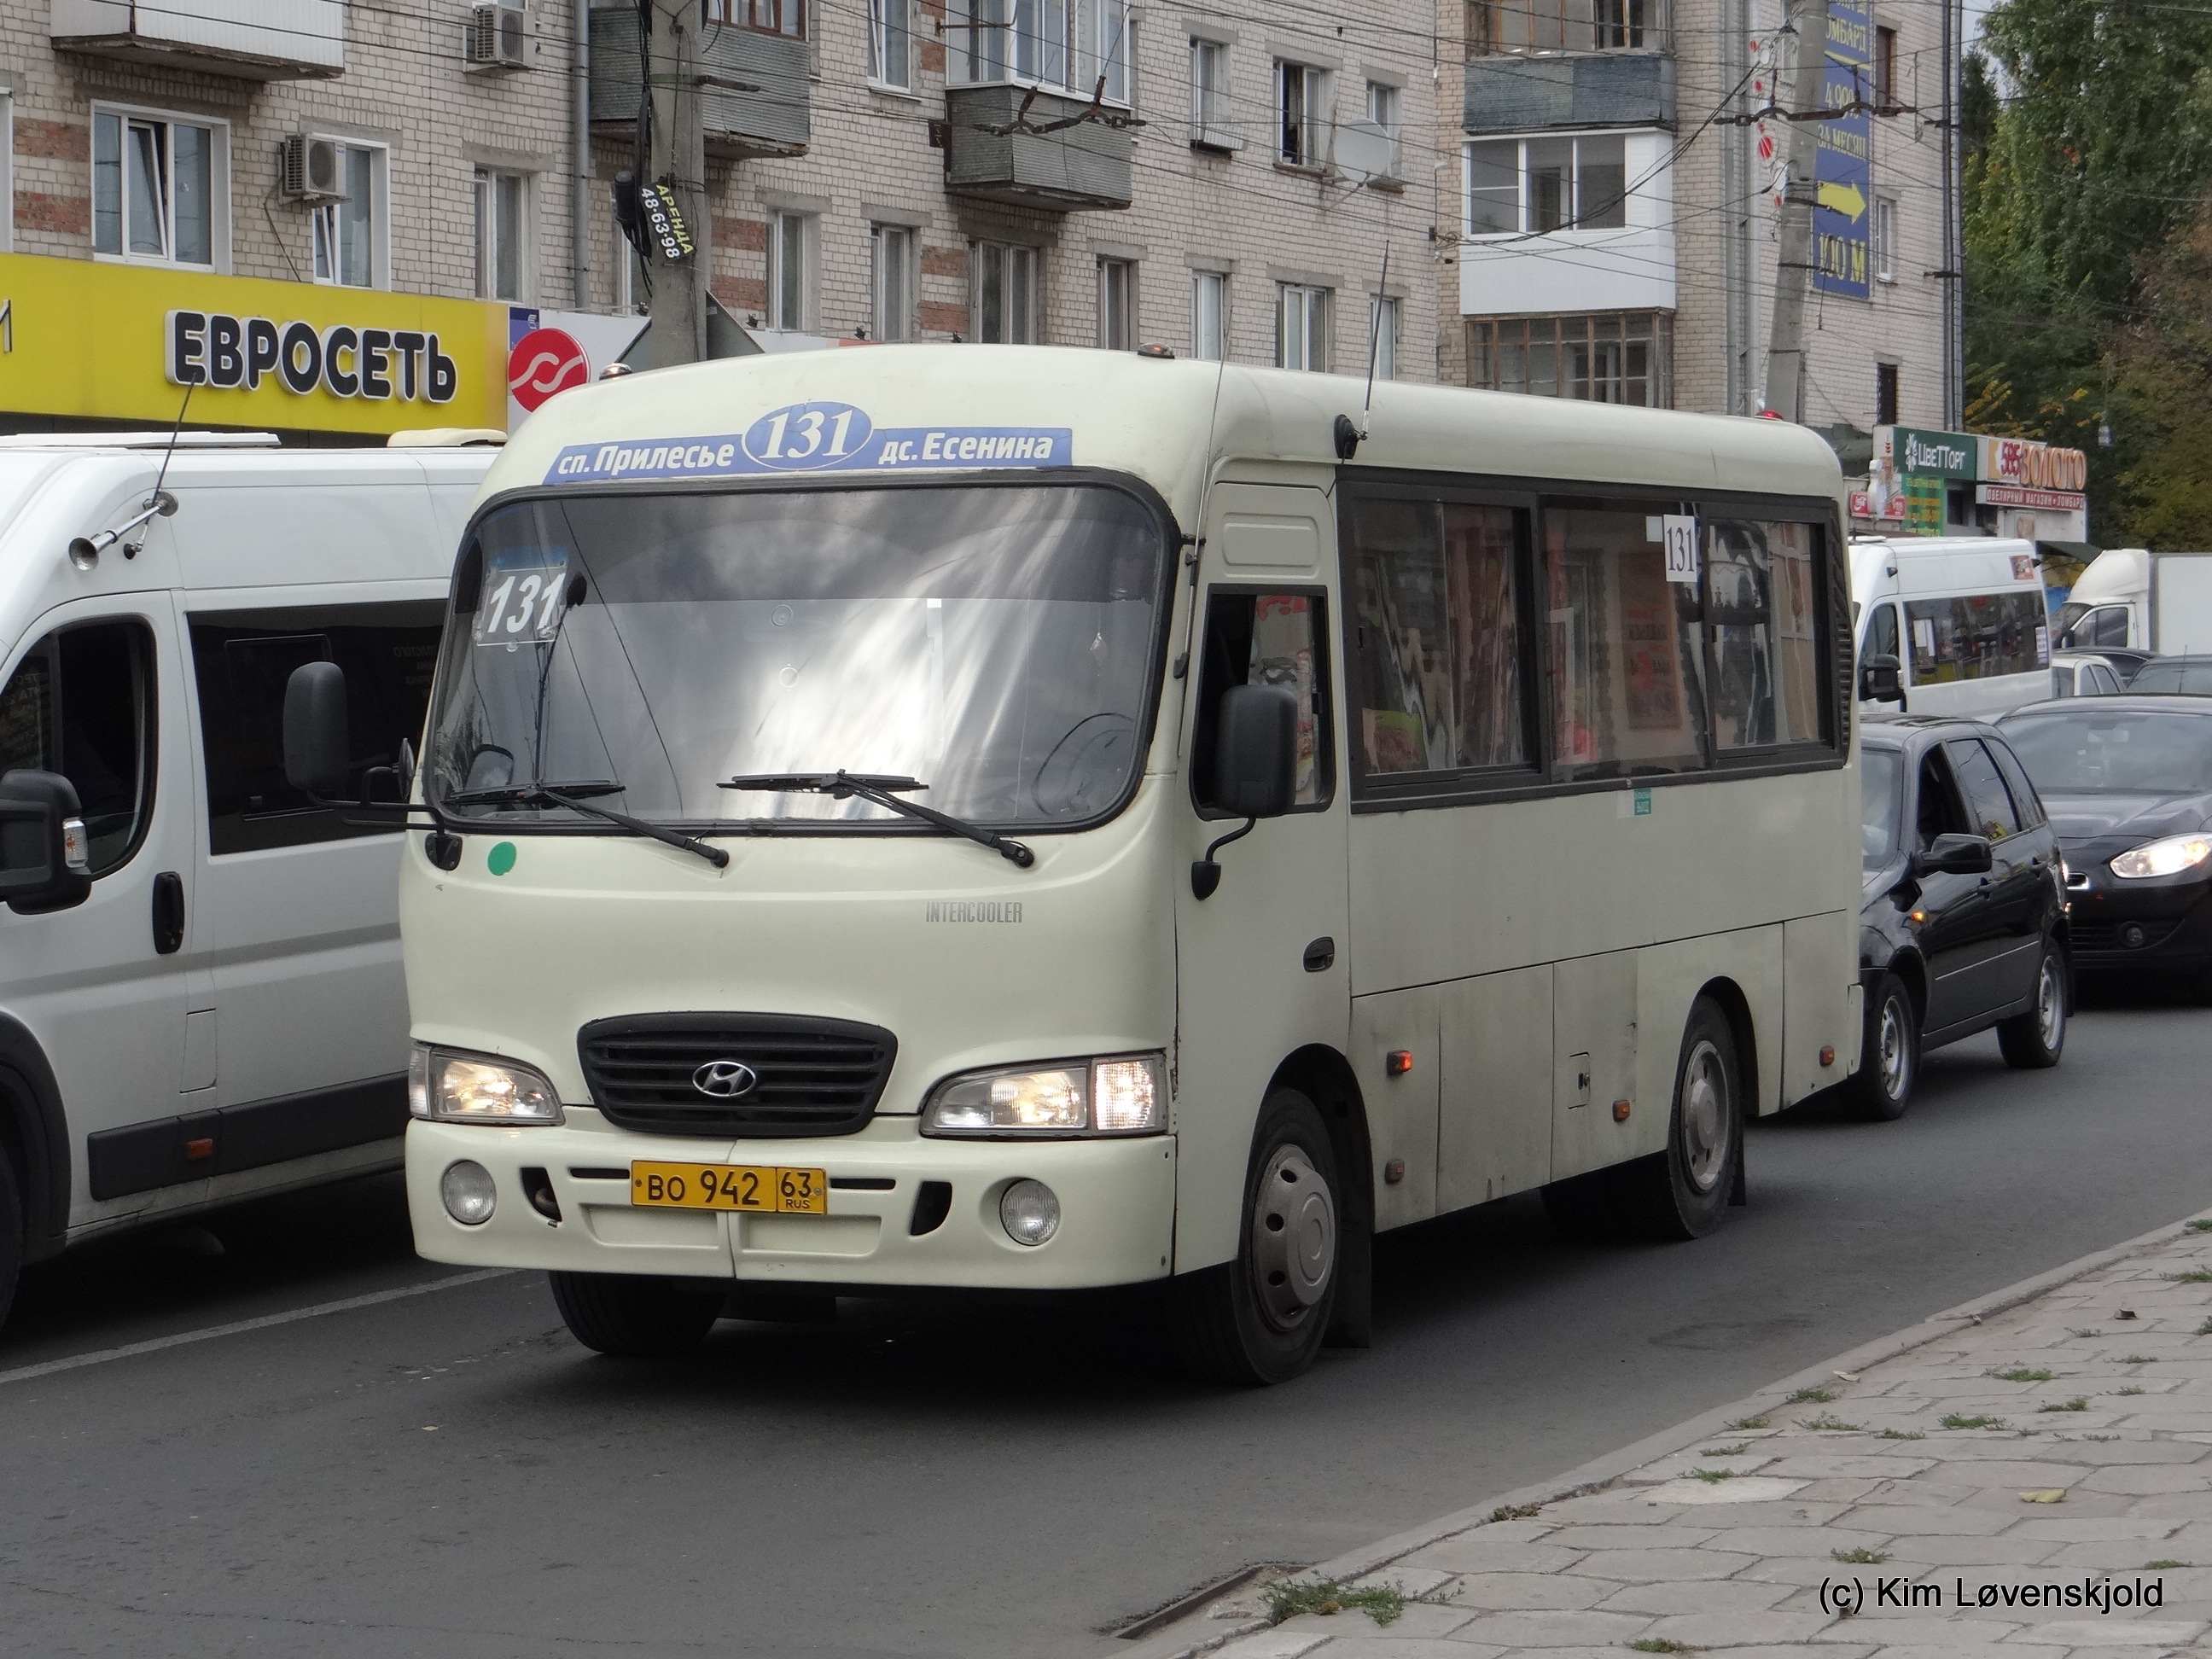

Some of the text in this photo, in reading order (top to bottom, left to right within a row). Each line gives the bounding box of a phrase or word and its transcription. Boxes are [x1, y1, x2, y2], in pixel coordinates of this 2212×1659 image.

[655, 184, 694, 253] АРЕНДА
[165, 309, 457, 405] ЕВРОСЕТЬ
[759, 409, 853, 459] 131
[1987, 487, 2084, 510] ЮВЕЛИРНЫЙ МАГАЗИН ЛОМБАРД
[1667, 526, 1695, 572] 131
[486, 573, 567, 634] 131
[925, 901, 1023, 923] INTERCOOLER
[648, 1169, 812, 1206] ВО 942 63
[785, 1198, 810, 1209] RUS
